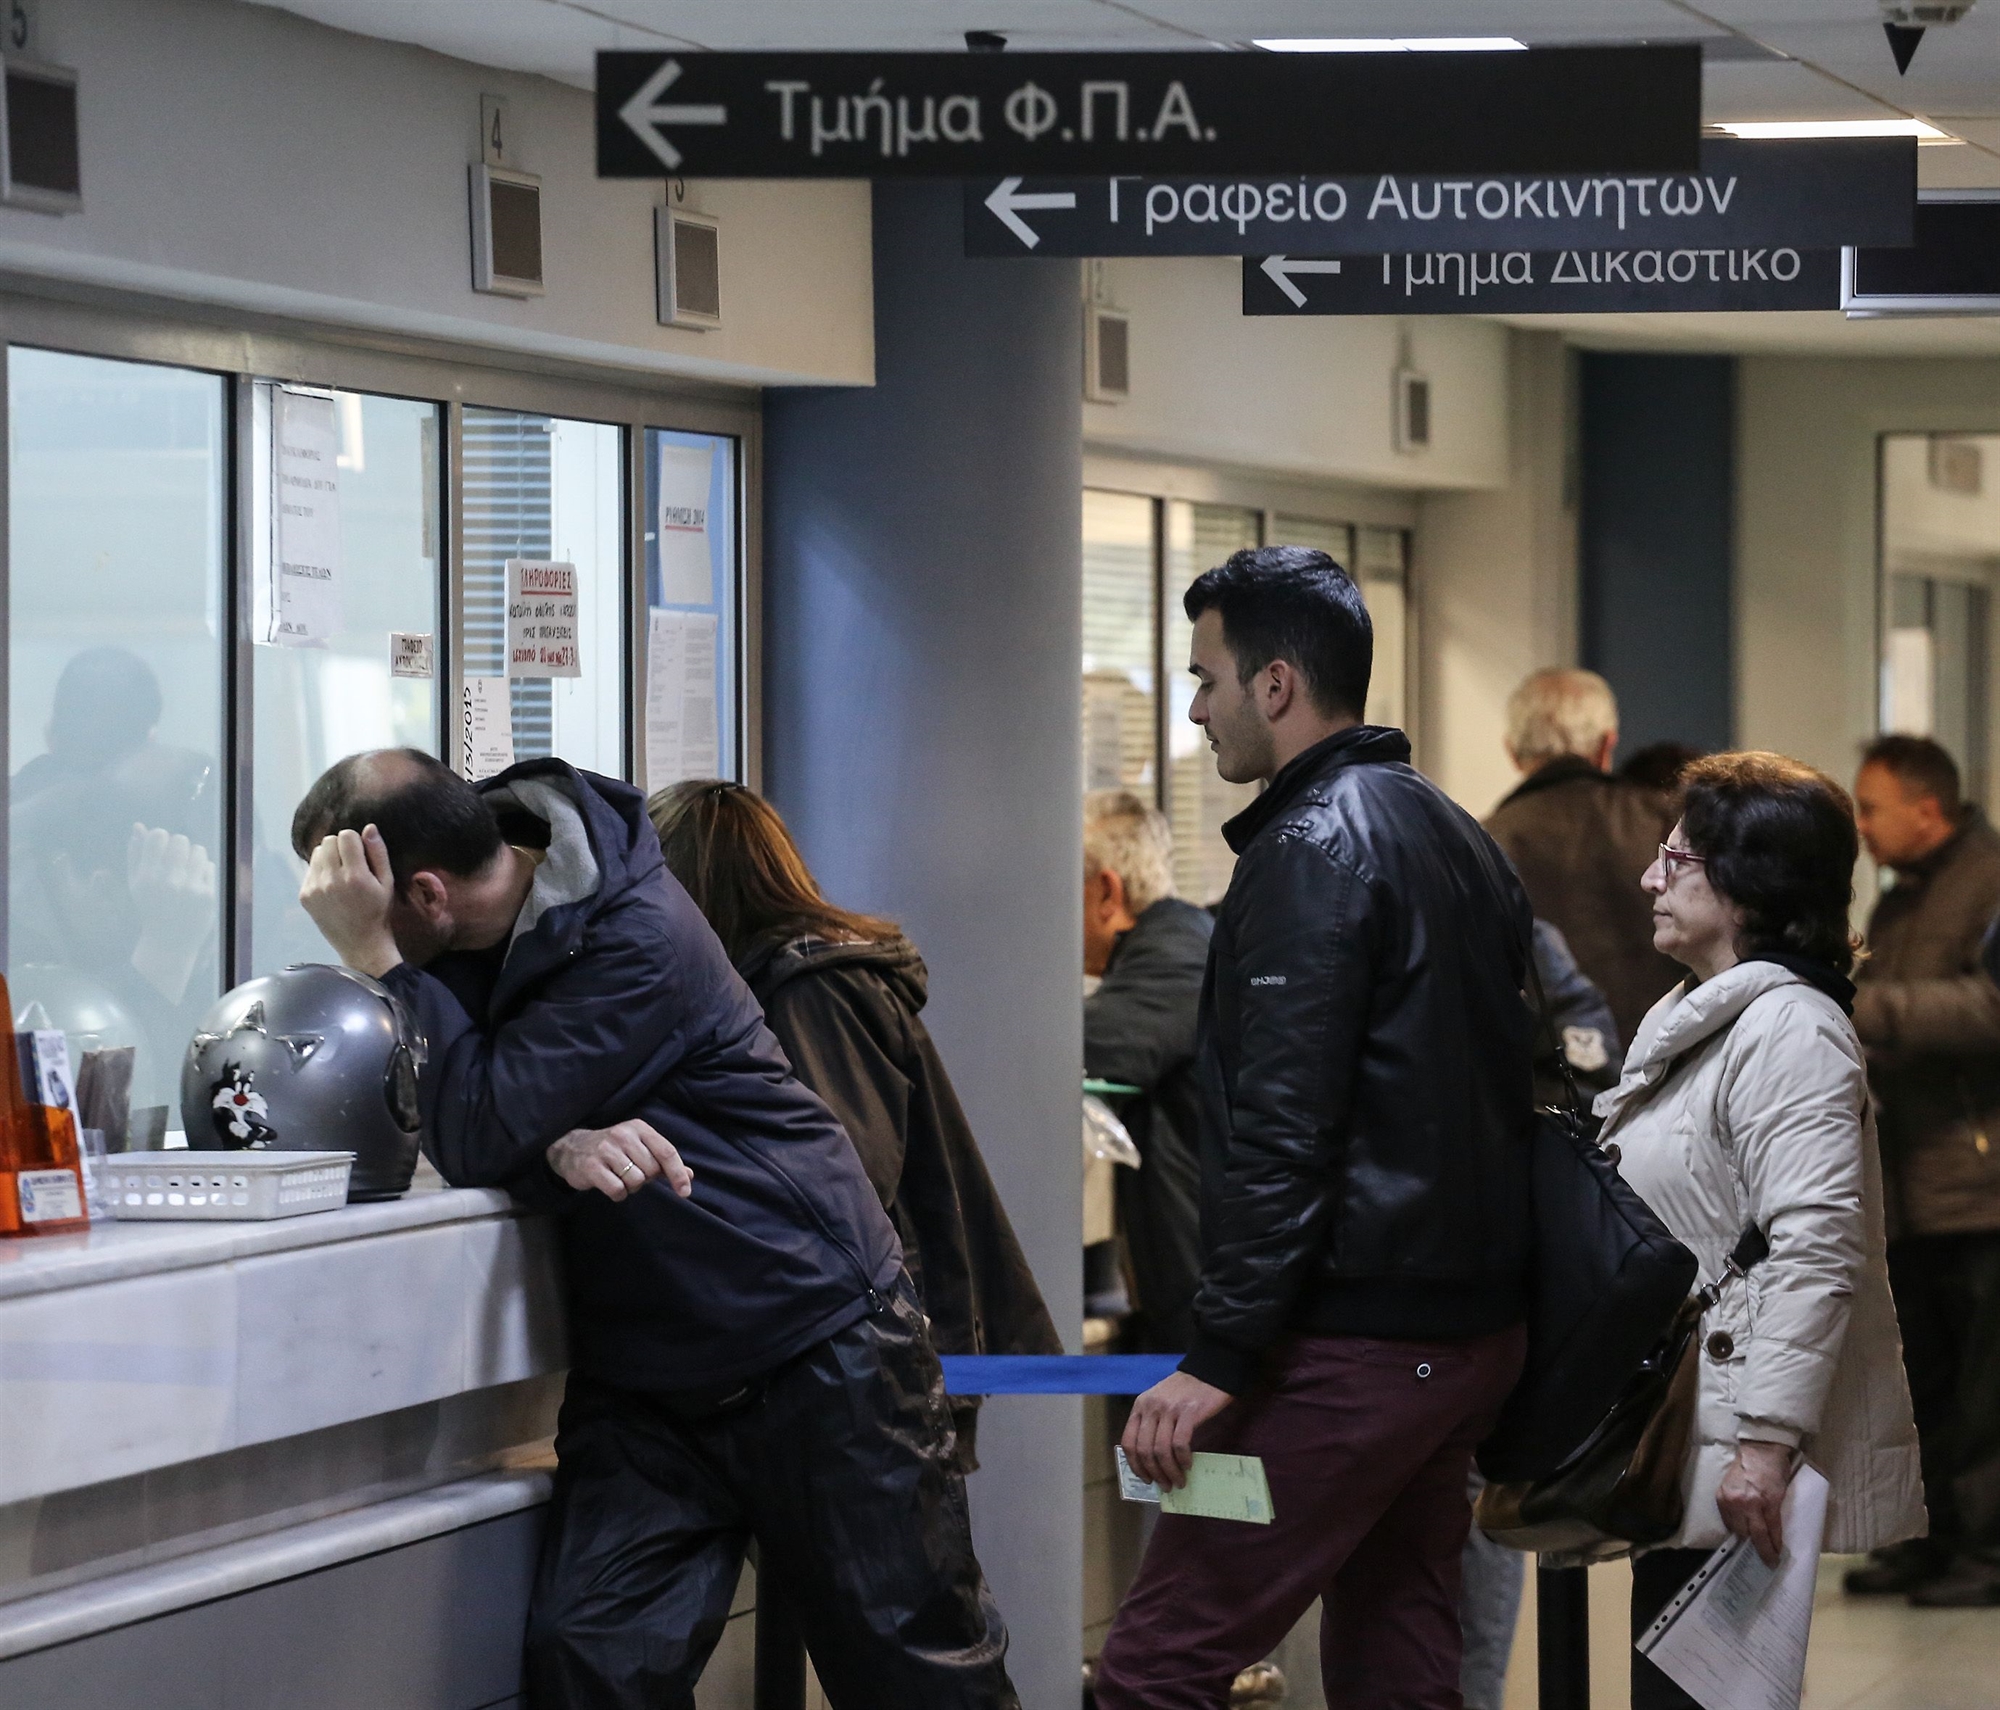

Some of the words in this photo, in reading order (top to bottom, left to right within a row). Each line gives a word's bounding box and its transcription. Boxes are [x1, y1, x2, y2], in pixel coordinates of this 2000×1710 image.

[491, 107, 503, 160] 4
[764, 77, 984, 157] Τμήμα
[1003, 79, 1218, 142] Φ.Π.Α.
